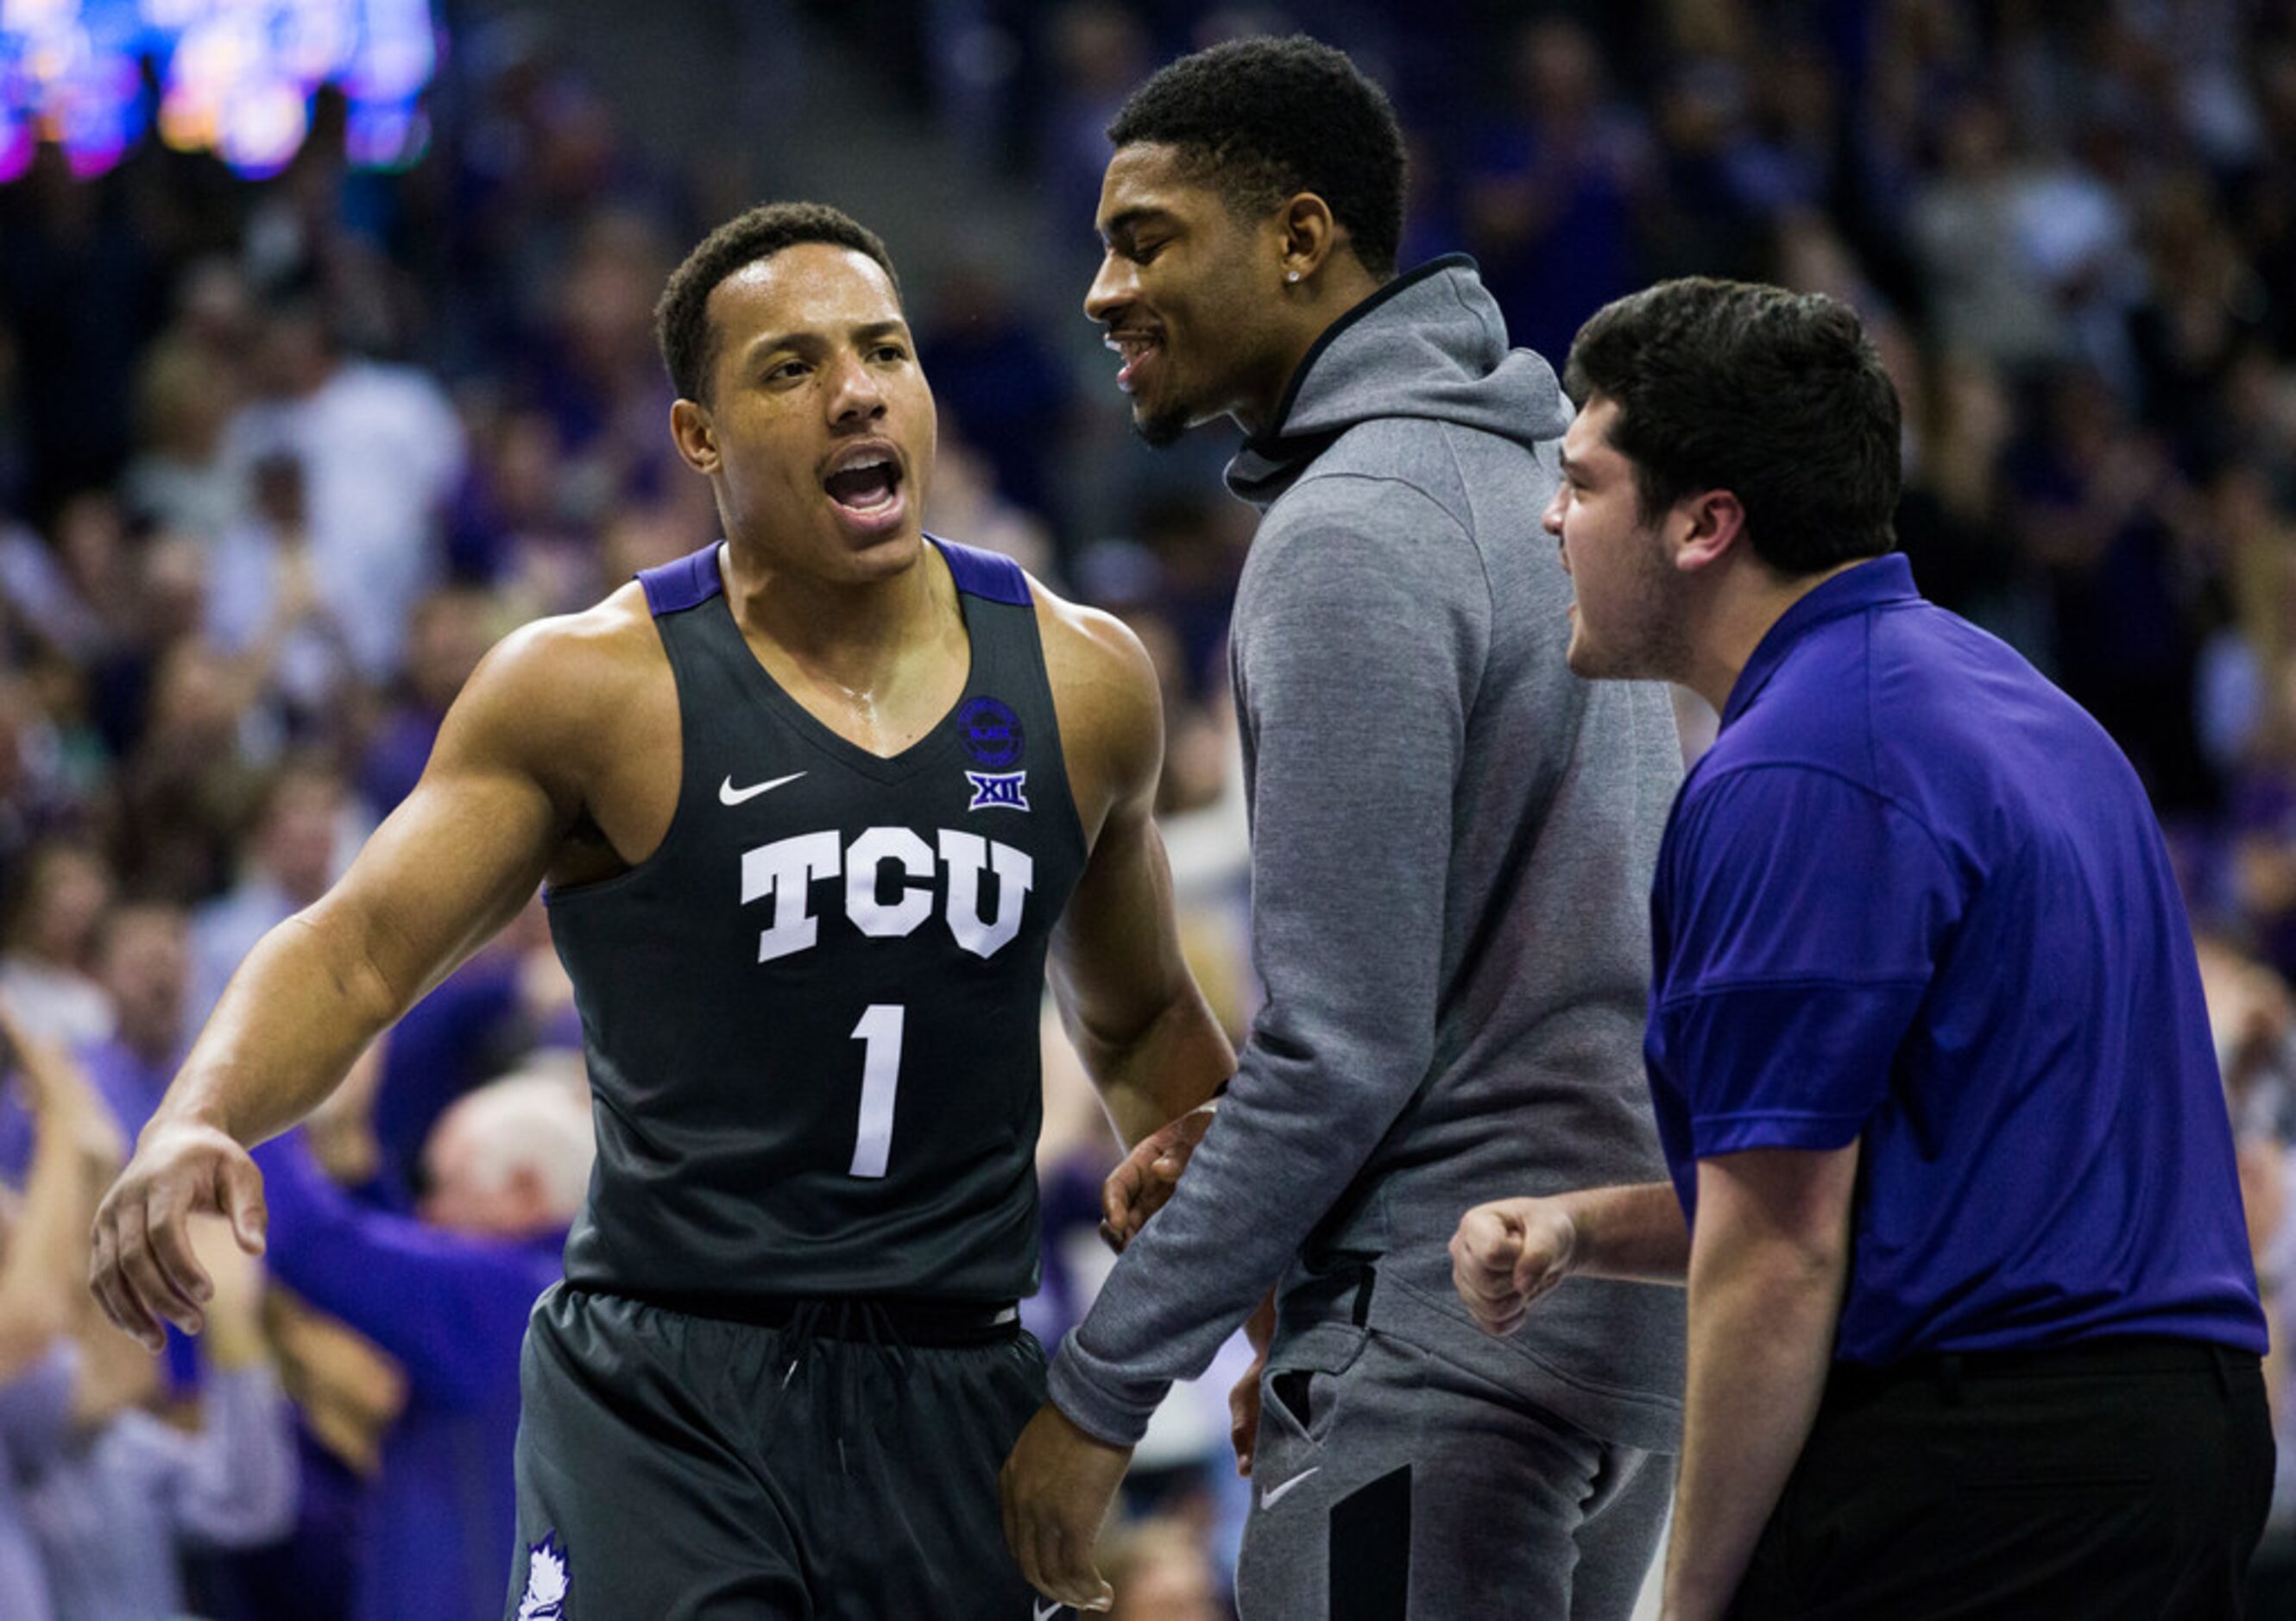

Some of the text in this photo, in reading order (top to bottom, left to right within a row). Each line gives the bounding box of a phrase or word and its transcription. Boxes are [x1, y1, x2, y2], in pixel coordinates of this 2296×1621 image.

[969, 774, 1026, 808] XII
[741, 826, 1033, 963] TCU
[849, 1004, 905, 1178] 1
